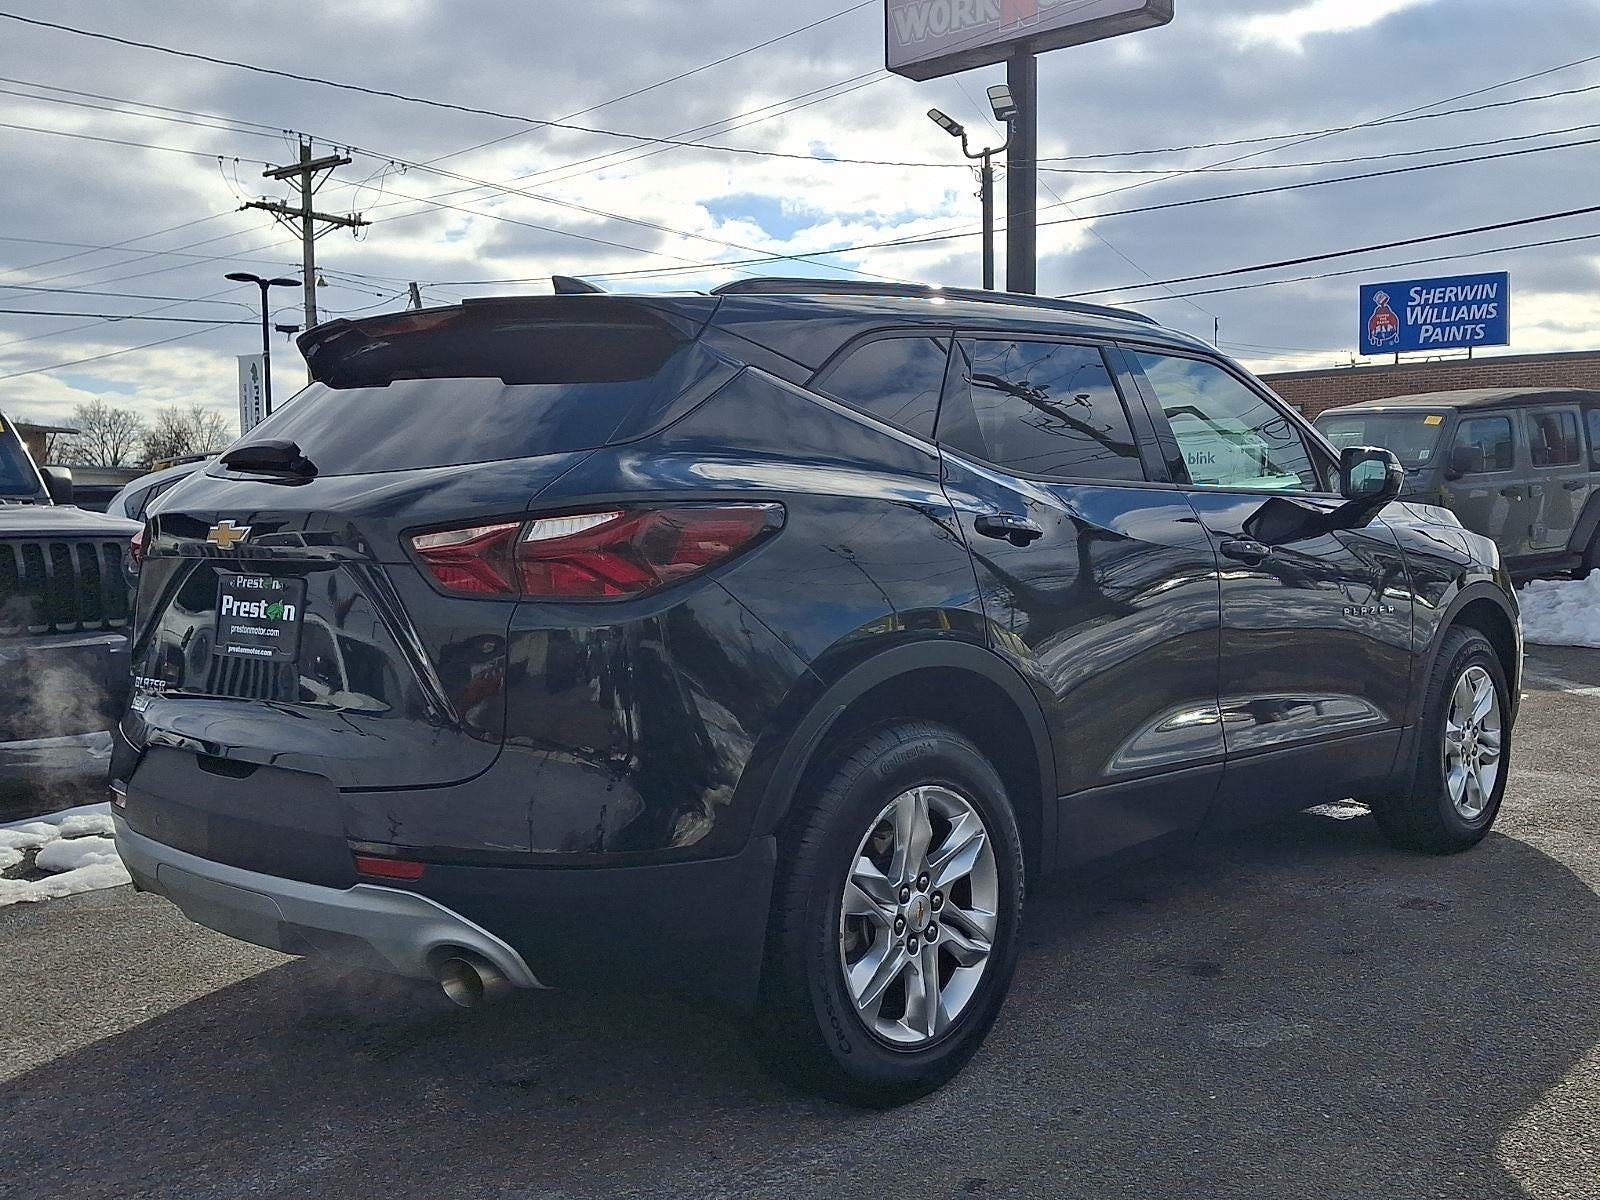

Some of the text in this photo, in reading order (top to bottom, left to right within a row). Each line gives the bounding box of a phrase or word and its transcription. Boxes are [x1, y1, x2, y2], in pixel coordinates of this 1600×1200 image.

[890, 0, 1000, 45] WORK
[1408, 283, 1498, 305] SHERWIN
[1406, 303, 1498, 325] WILLIAMS
[1419, 324, 1486, 343] PAINTS
[1187, 451, 1216, 465] blink
[221, 595, 296, 622] Preston
[1341, 605, 1395, 616] BLAZER
[230, 625, 280, 637] prestonmotor.com
[227, 646, 273, 656] prestonmotor.com
